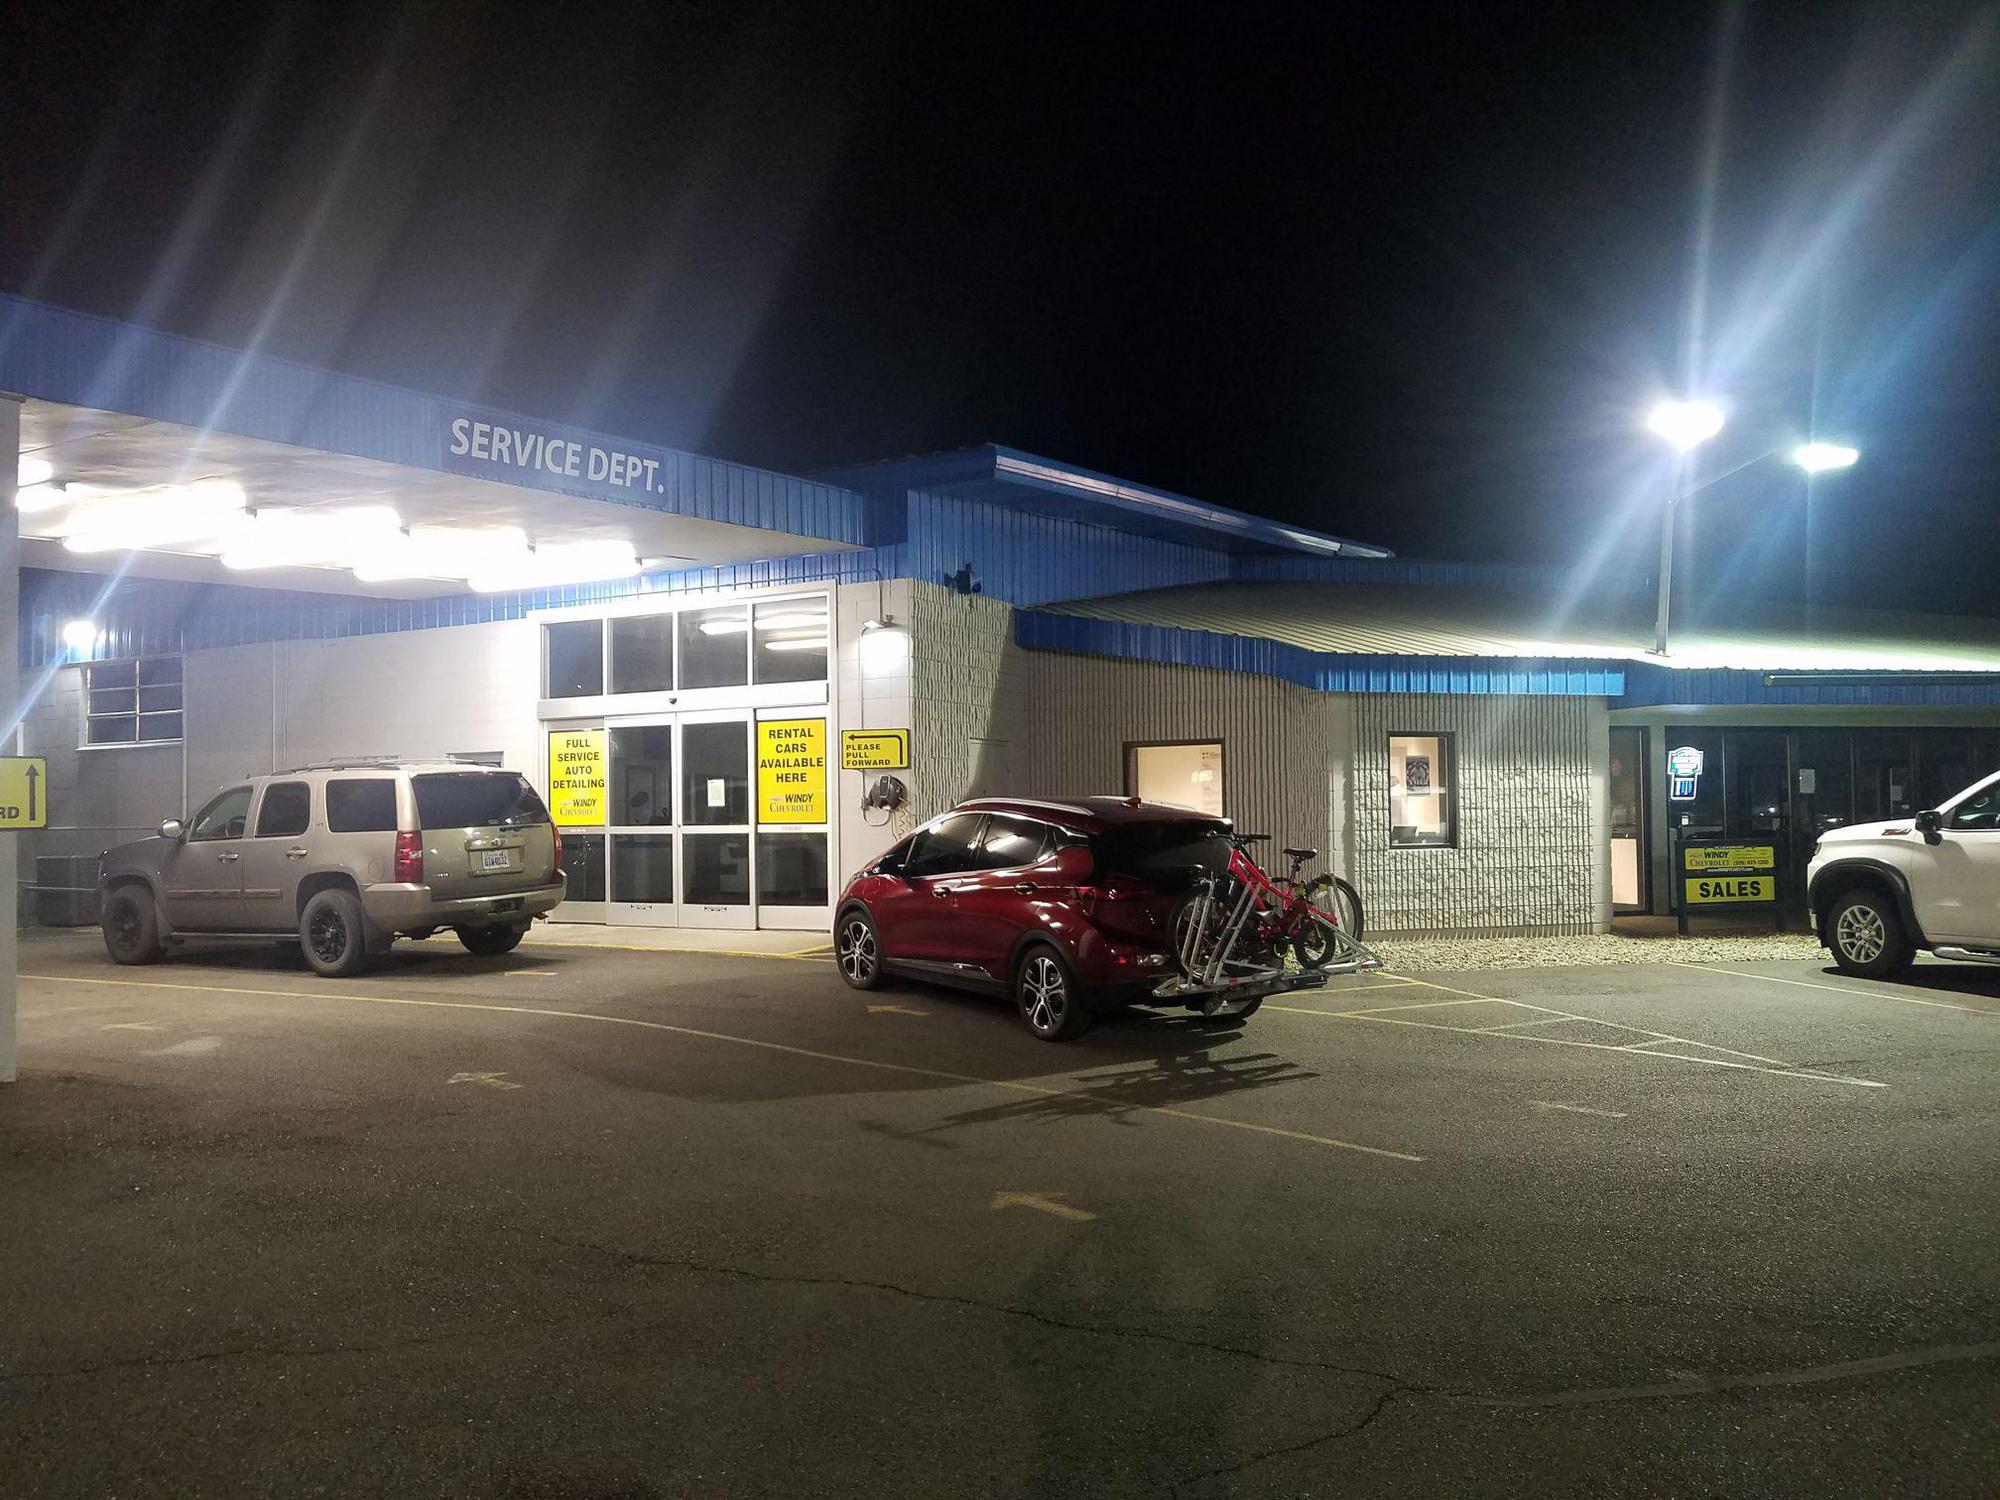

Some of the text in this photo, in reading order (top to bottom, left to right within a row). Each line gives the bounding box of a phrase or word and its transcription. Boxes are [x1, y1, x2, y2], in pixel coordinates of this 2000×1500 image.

[450, 418, 665, 494] SERVICE DEPT.
[768, 728, 814, 739] RENTAL
[566, 739, 591, 748] FULL
[775, 743, 807, 753] CARS
[846, 743, 881, 751] PLEASE
[558, 752, 600, 762] SERVICE
[760, 758, 823, 769] AVAILABLE
[846, 759, 891, 767] FORWARD
[565, 766, 592, 775] AUTO
[776, 773, 807, 783] HERE
[553, 779, 605, 789] DETAILING
[573, 799, 597, 807] WINDY
[785, 794, 814, 803] WINDY
[770, 803, 814, 813] CHEVROLET
[1704, 851, 1729, 859] WINDY
[1699, 881, 1762, 898] SALES
